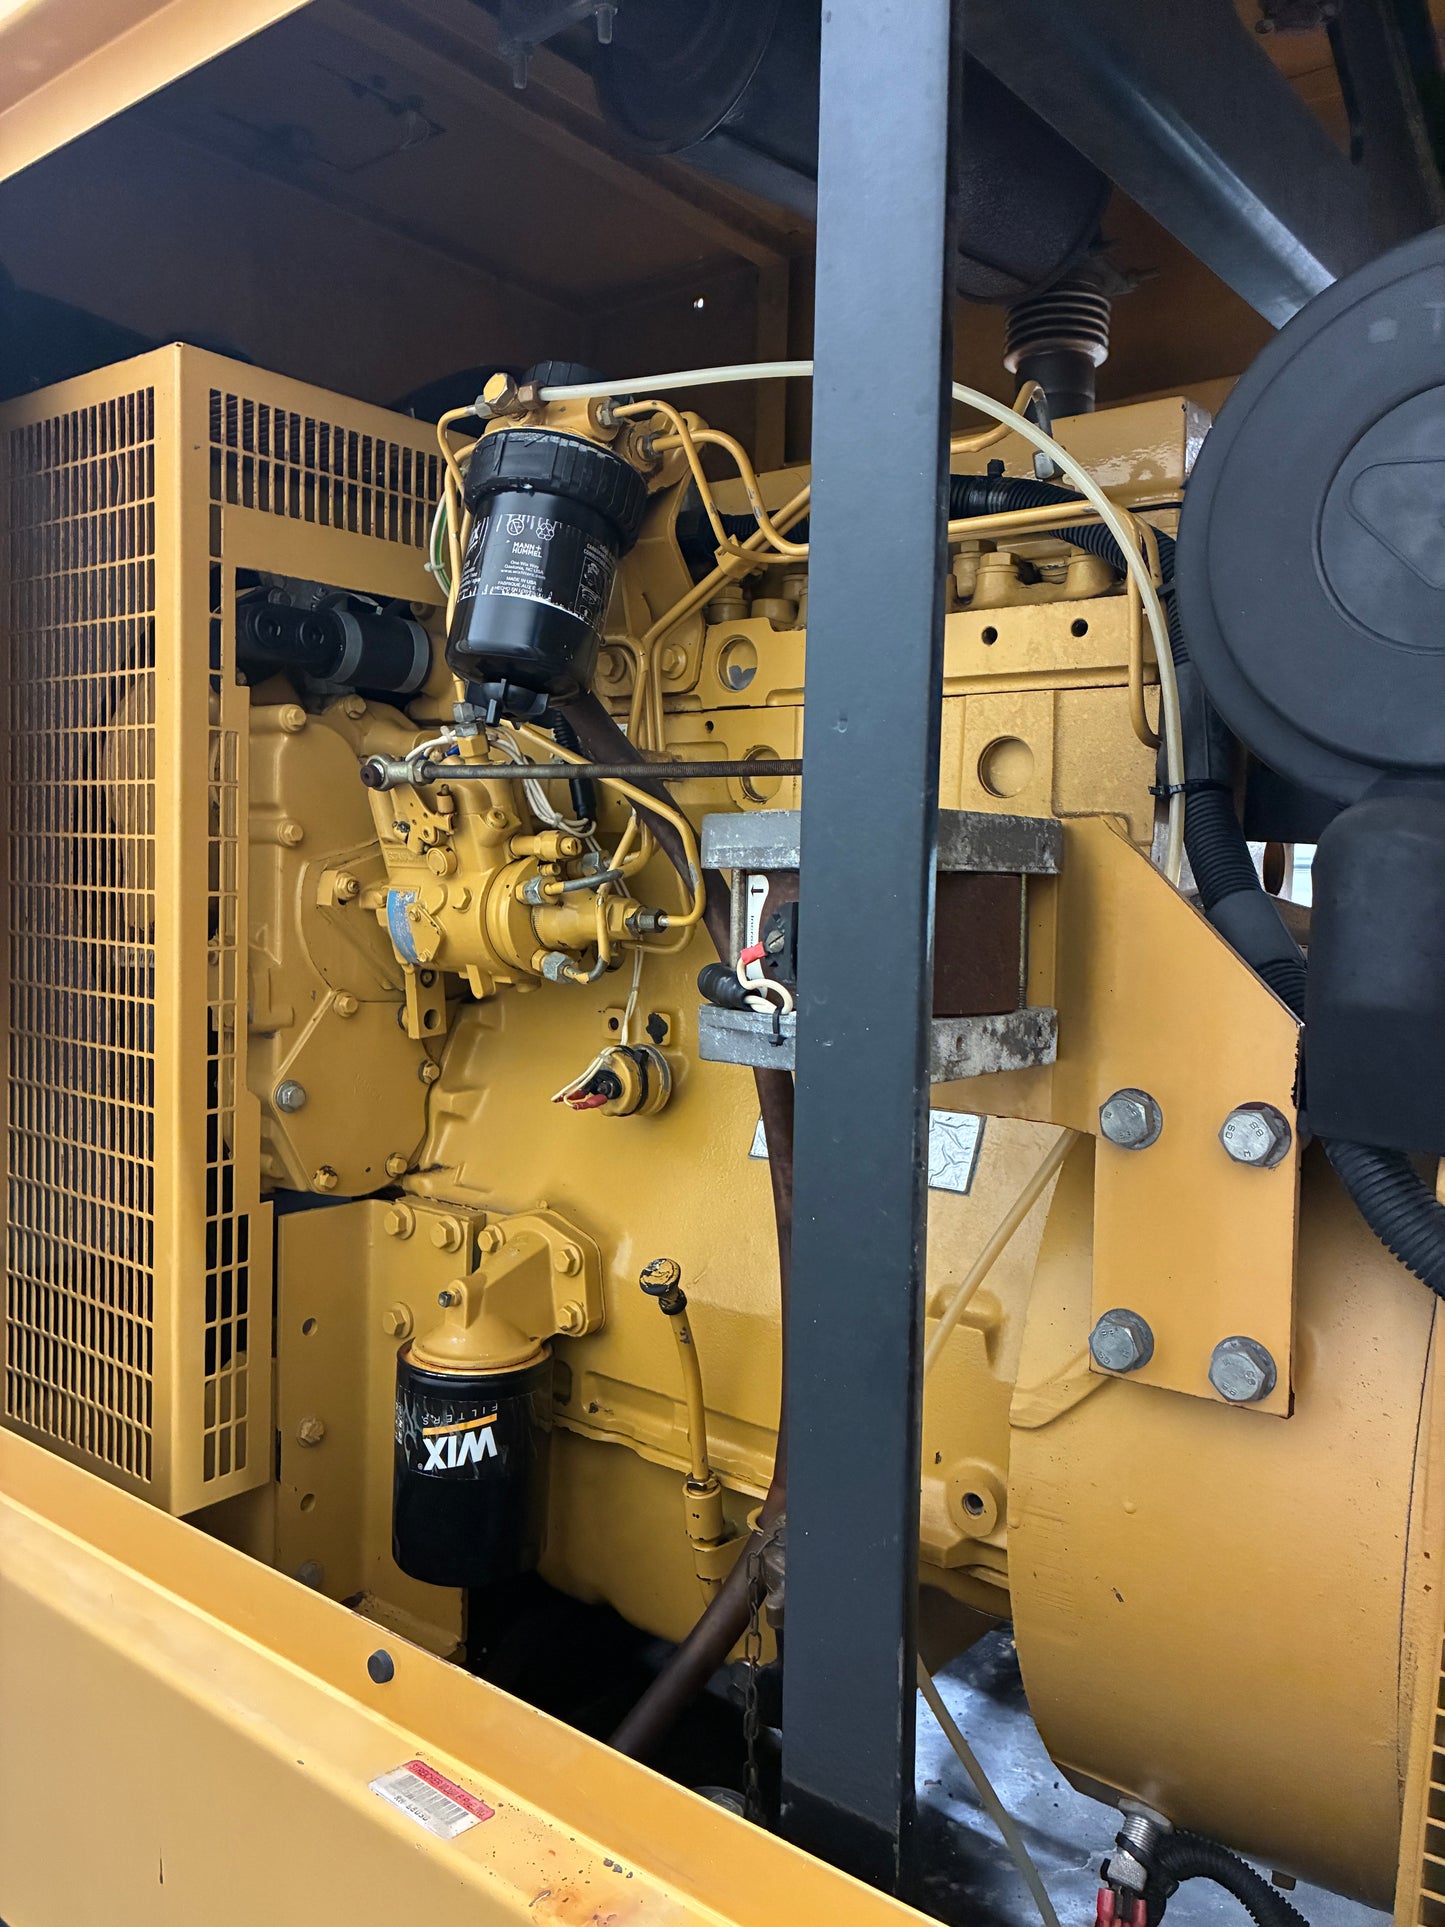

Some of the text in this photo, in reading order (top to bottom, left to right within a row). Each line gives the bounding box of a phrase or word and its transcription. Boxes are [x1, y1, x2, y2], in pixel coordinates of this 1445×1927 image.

[512, 547, 543, 558] HUMMEL
[422, 1402, 498, 1426] FILTERS
[423, 1426, 498, 1471] WIX
